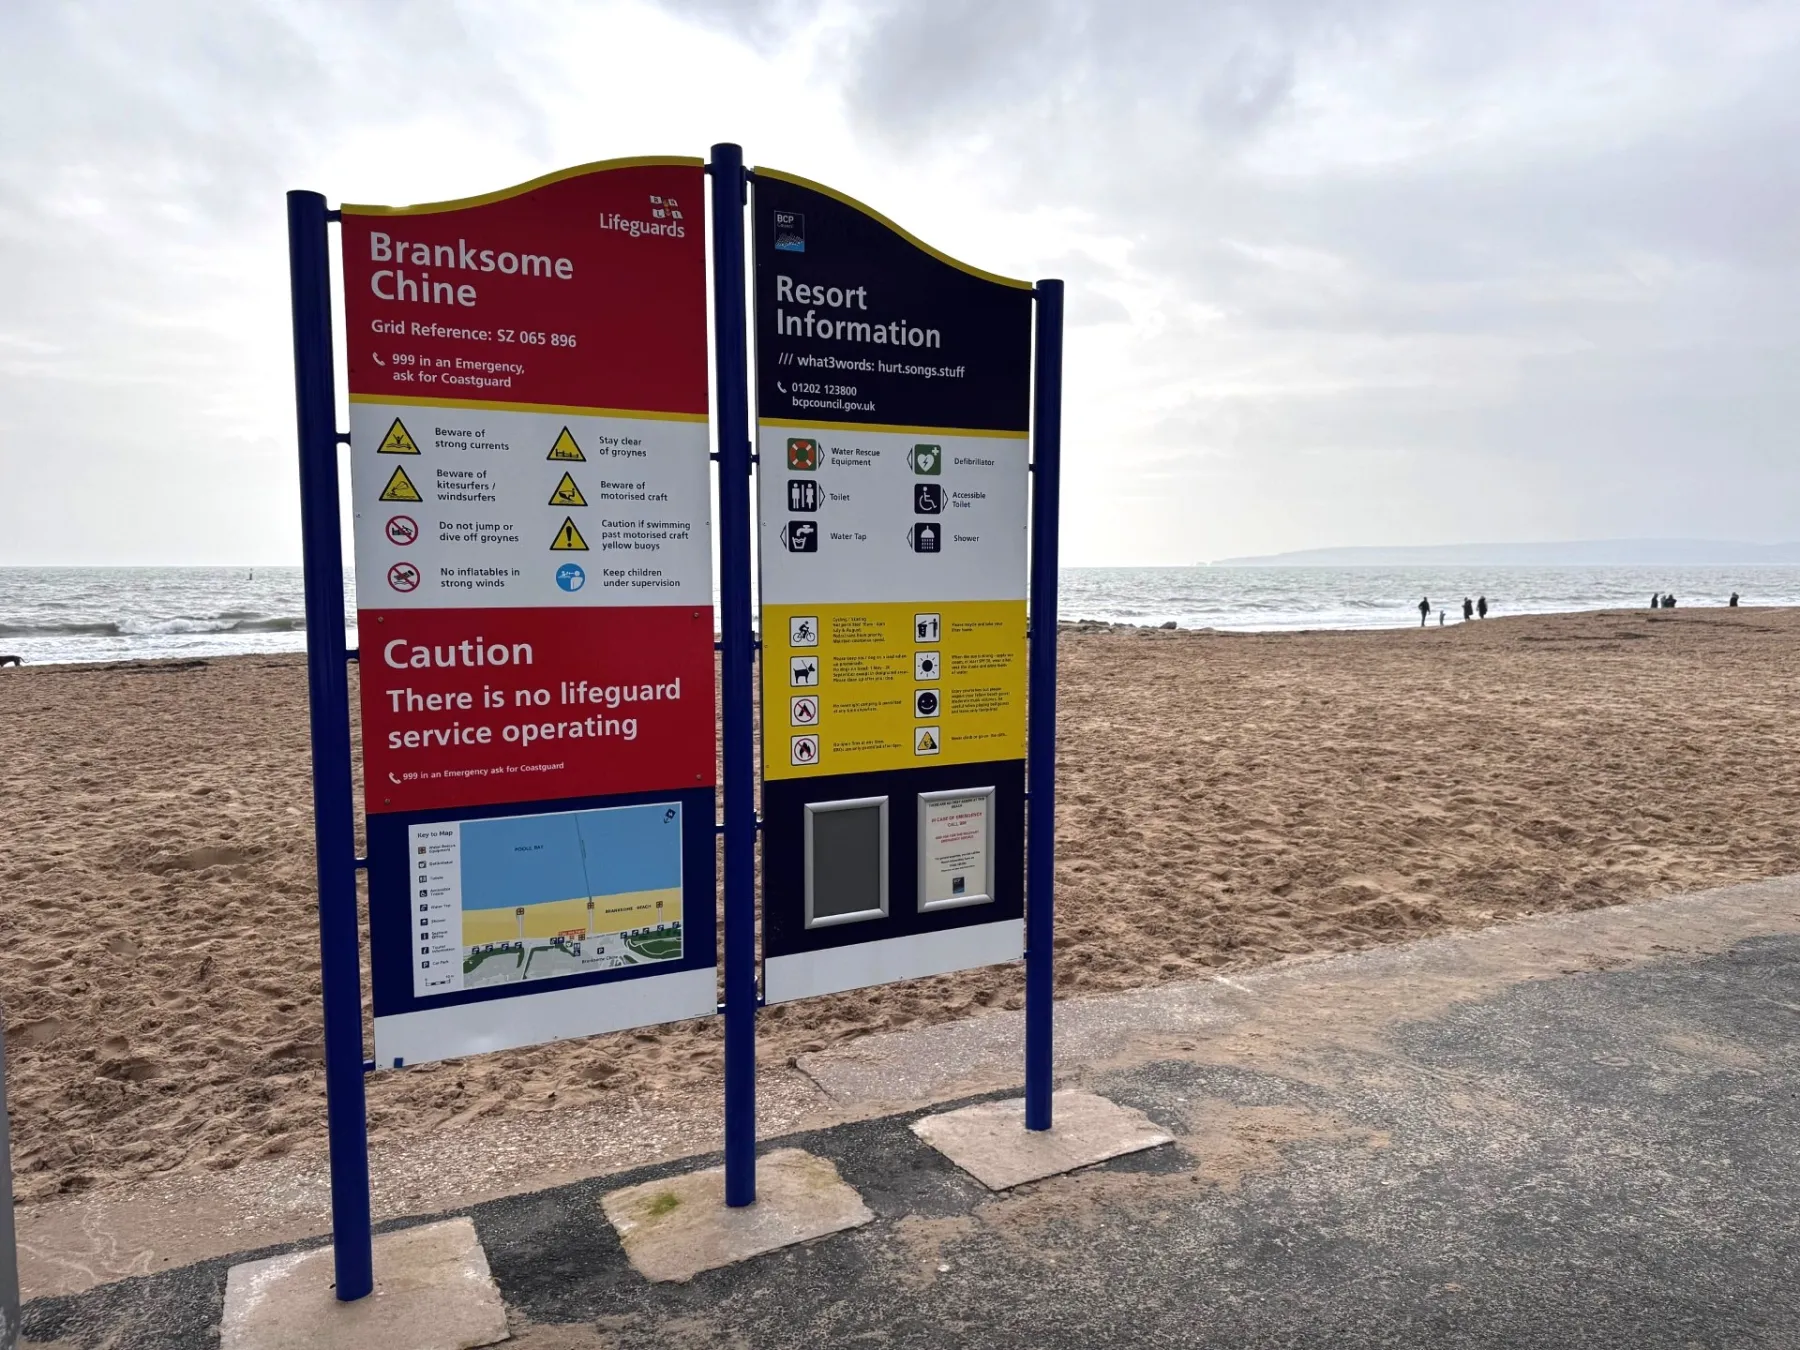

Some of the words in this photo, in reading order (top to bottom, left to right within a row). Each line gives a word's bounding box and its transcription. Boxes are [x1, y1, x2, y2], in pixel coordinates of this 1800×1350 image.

[600, 210, 684, 237] Lifeguards
[777, 214, 794, 223] BCP
[371, 232, 573, 282] Branksome
[371, 270, 476, 306] Chine
[777, 275, 867, 310] Resort
[372, 320, 404, 334] Grid
[412, 322, 491, 340] Reference:
[498, 329, 514, 342] SZ
[520, 331, 545, 345] 065
[551, 333, 576, 347] 896
[778, 309, 940, 348] Information
[393, 354, 415, 365] 999
[420, 355, 431, 366] in
[436, 359, 450, 368] an
[456, 358, 524, 375] Emergency,
[797, 354, 874, 371] what3words:
[878, 360, 965, 378] hurt.songs.stuff
[393, 370, 414, 381] ask
[418, 371, 437, 382] for
[441, 373, 511, 388] Coastguard
[792, 382, 820, 393] 01202
[824, 385, 857, 396] 123800
[793, 396, 875, 412] bcpcouncil.gov.uk
[435, 428, 471, 437] Beware
[475, 429, 485, 437] of
[436, 440, 467, 450] strong
[599, 436, 618, 446] Stay
[621, 437, 641, 445] clear
[600, 447, 609, 455] of
[612, 450, 646, 458] groynes
[832, 458, 871, 466] Equipment
[437, 469, 473, 478] Beware
[477, 470, 486, 478] of
[437, 480, 489, 490] kitesurfers
[601, 481, 633, 489] Beware
[438, 492, 495, 501] windsurfers
[648, 493, 667, 501] craft
[830, 493, 849, 501] Toilet
[440, 521, 453, 529] Do
[476, 522, 500, 532] jump
[639, 520, 644, 528] if
[647, 521, 690, 530] swimming
[440, 533, 460, 541] dive
[464, 533, 477, 541] off
[481, 535, 519, 543] groynes
[669, 531, 688, 539] craft
[854, 533, 866, 541] Tap
[602, 541, 632, 551] yellow
[635, 542, 660, 551] buoys
[441, 568, 454, 576] No
[458, 568, 508, 576] inflatables
[512, 568, 520, 576] in
[604, 569, 625, 577] Keep
[628, 568, 661, 576] children
[441, 580, 472, 589] strong
[476, 579, 504, 587] winds
[632, 579, 680, 588] supervision
[384, 637, 532, 668] Caution
[386, 688, 472, 712] There
[484, 685, 504, 708] is
[516, 689, 550, 706] no
[562, 677, 680, 708] lifeguard
[389, 722, 491, 748] service
[503, 714, 637, 746] operating
[403, 772, 418, 780] 999
[444, 769, 488, 777] Emergency
[520, 762, 564, 772] Coastguard
